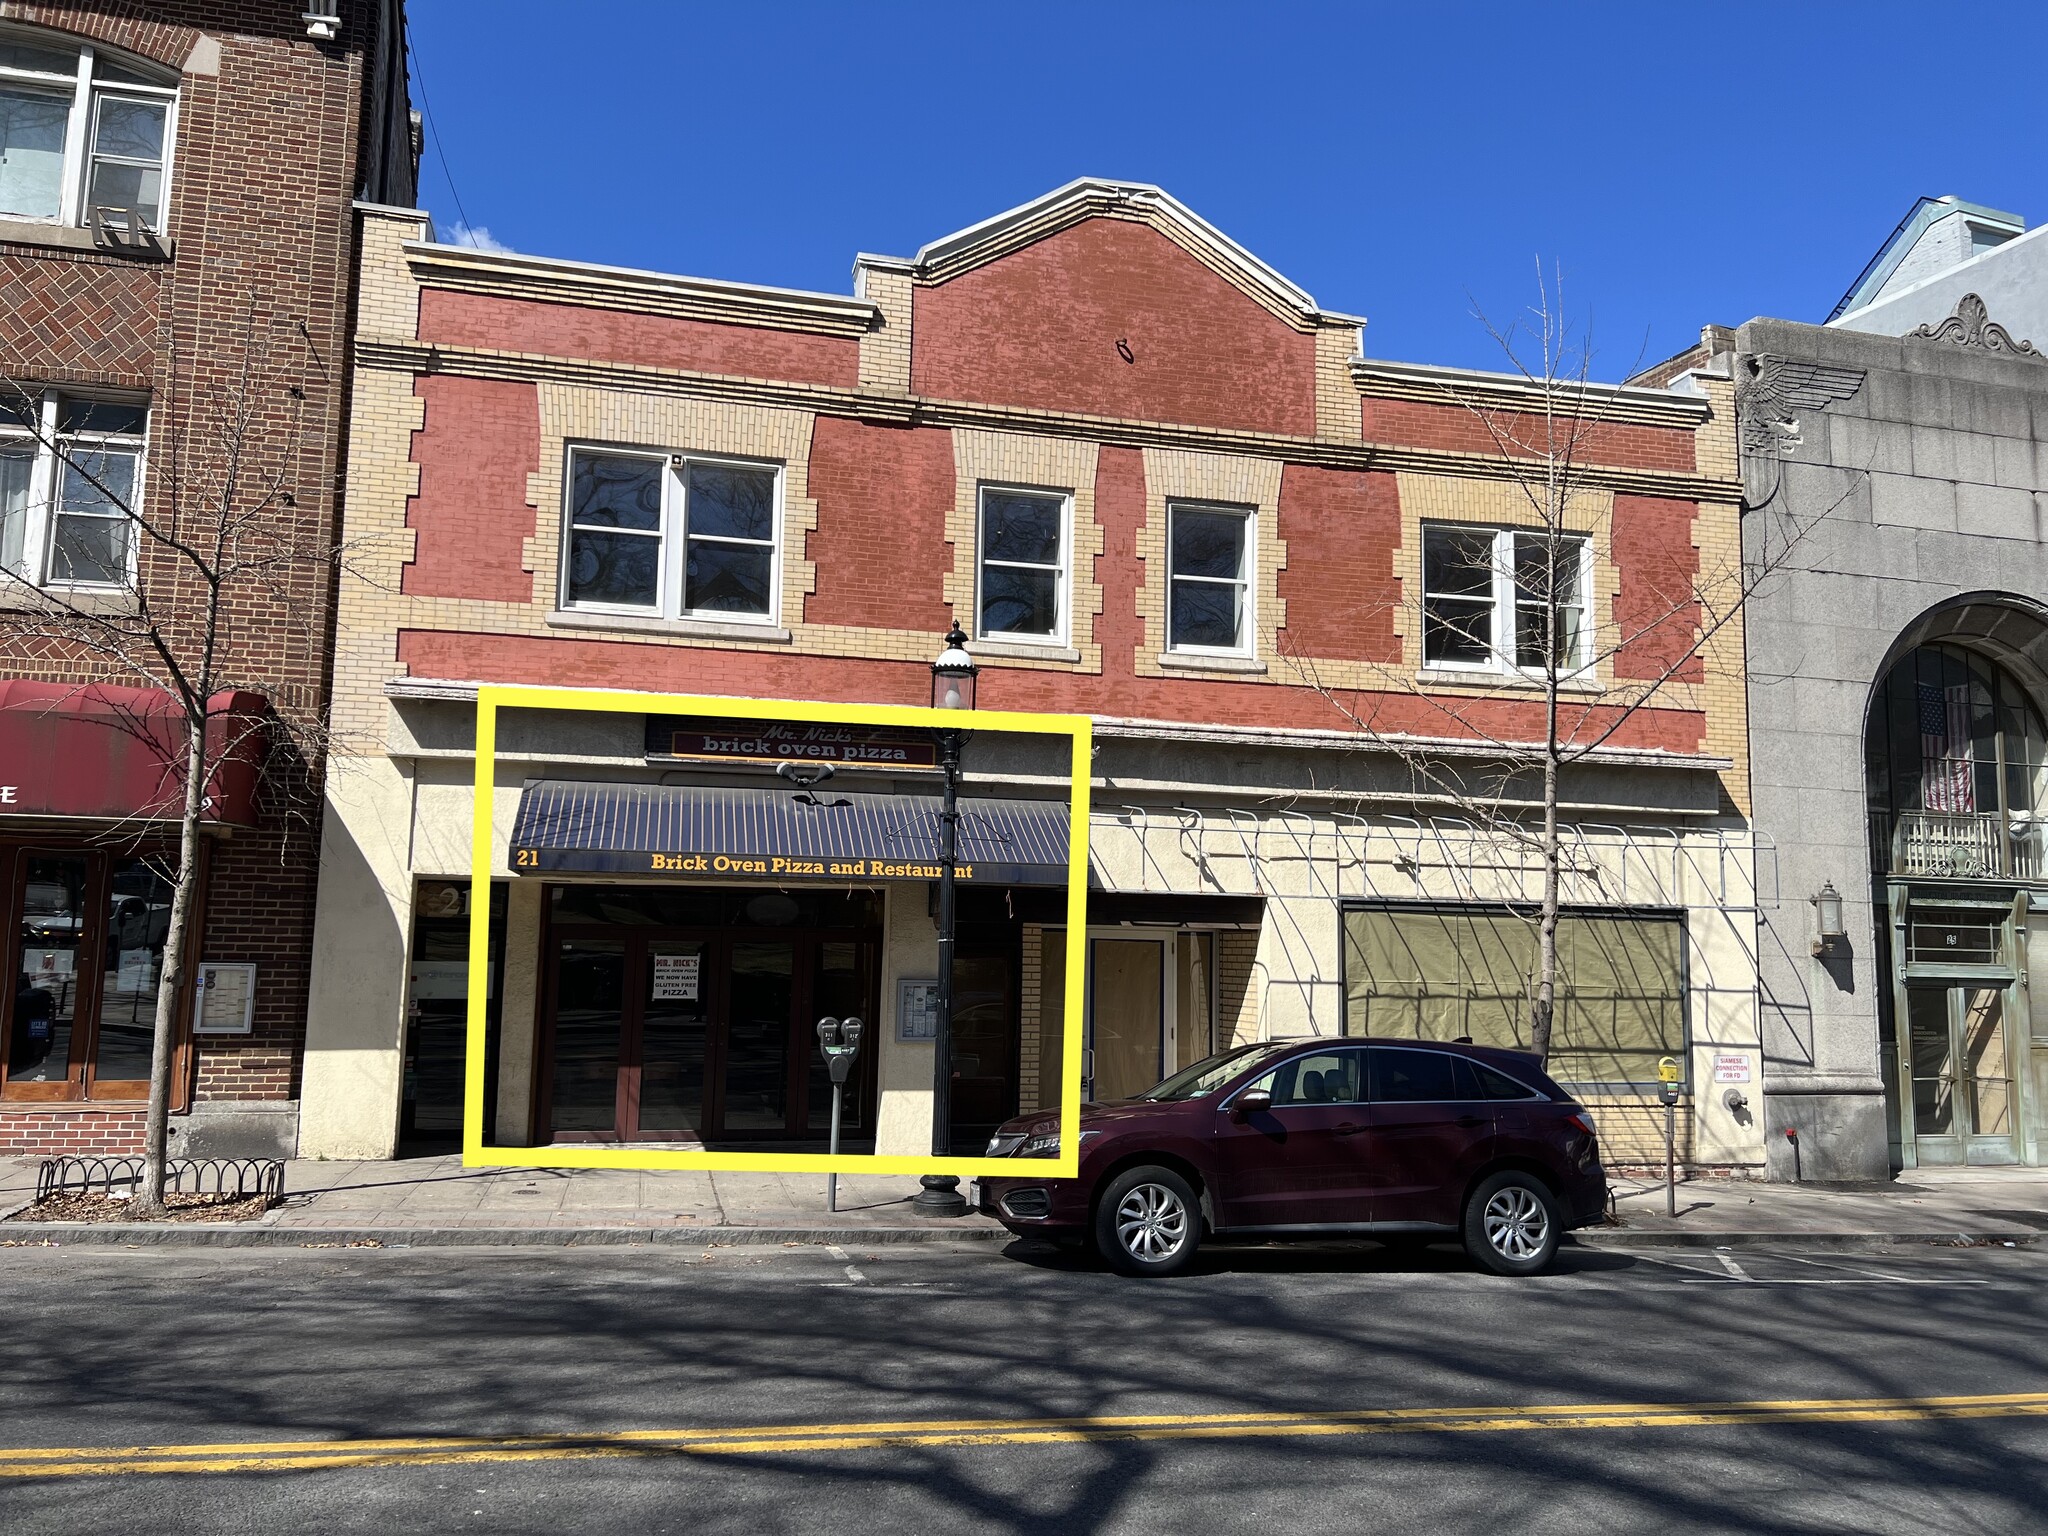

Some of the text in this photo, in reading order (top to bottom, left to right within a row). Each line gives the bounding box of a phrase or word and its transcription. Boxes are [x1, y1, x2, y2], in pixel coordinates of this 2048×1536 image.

[762, 725, 852, 743] Mr. Nick's
[702, 736, 907, 760] brick oven pizza
[516, 849, 539, 866] 21
[651, 853, 973, 878] Brick Oven Pizza and Restaurnt
[1946, 934, 1957, 945] 25
[656, 959, 671, 967] MR.
